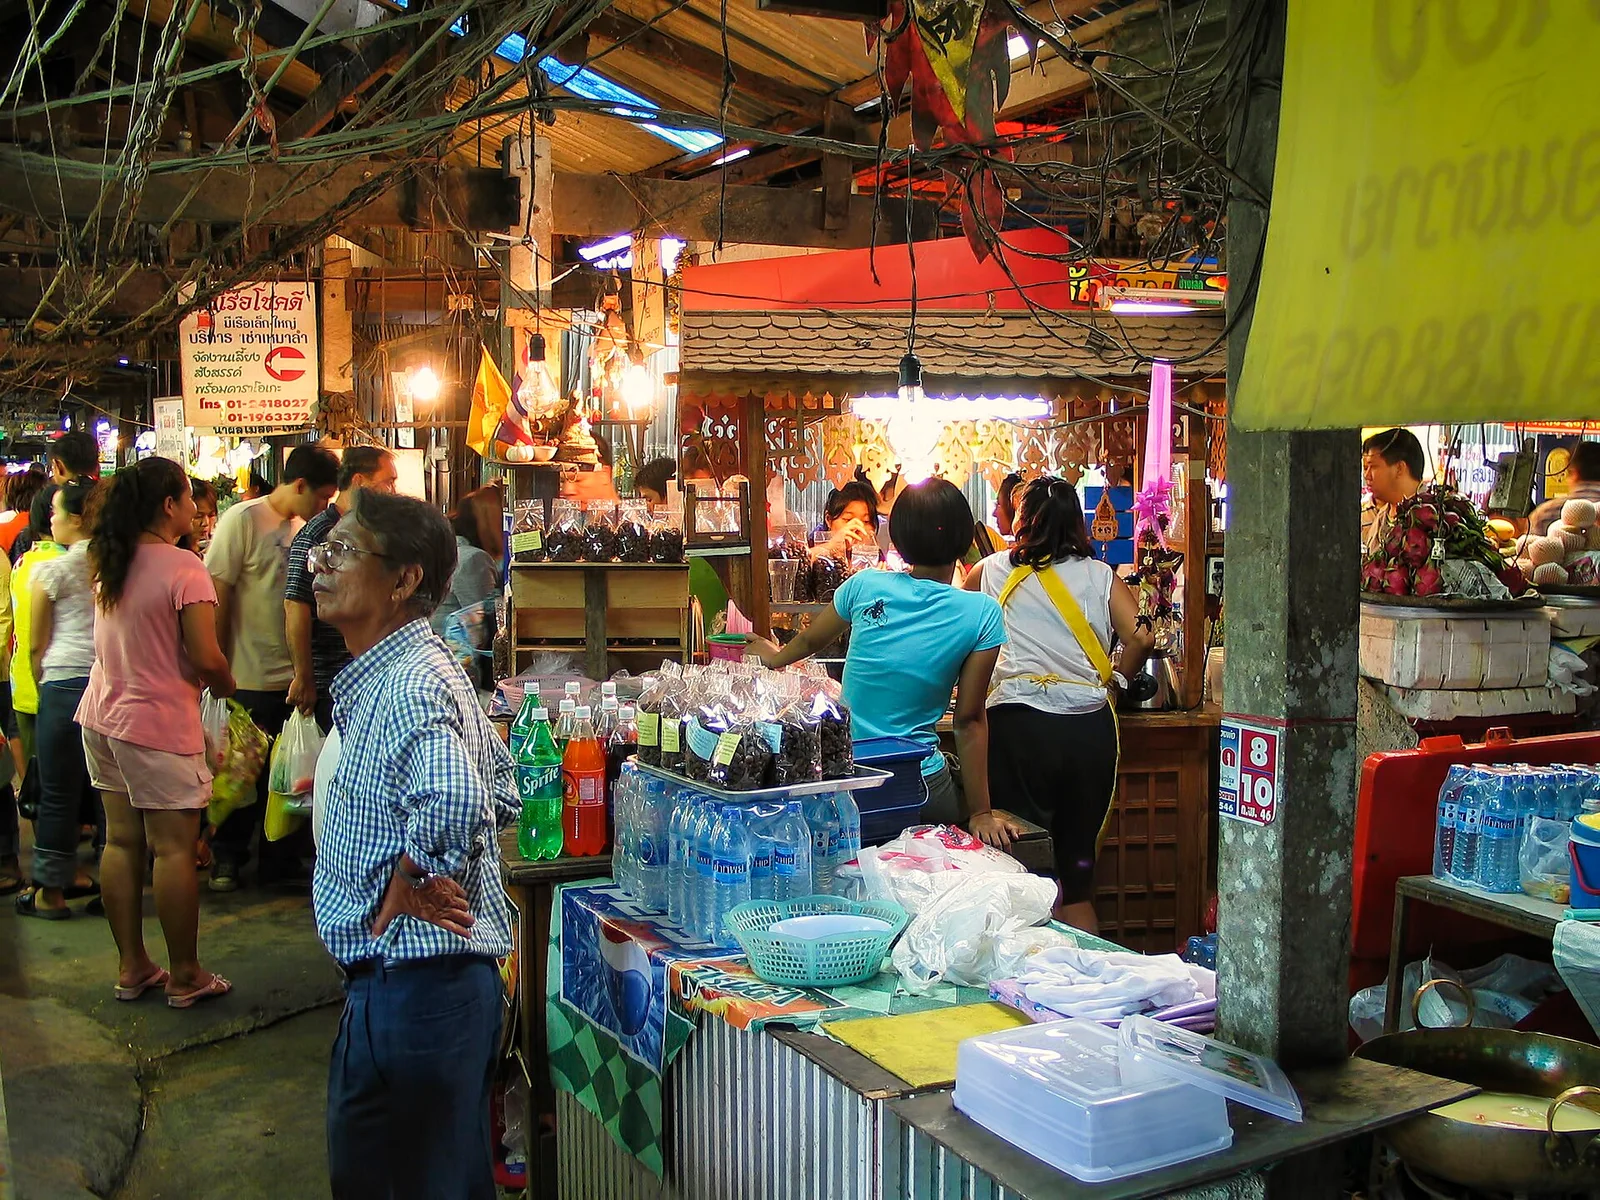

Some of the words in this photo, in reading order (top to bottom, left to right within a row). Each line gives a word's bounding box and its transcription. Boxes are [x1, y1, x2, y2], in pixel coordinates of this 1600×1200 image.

[215, 287, 305, 311] เรือโชคดี
[241, 330, 308, 344] เช่าเหมาลำ
[192, 347, 260, 363] จัดงานเลี้ยง
[199, 397, 221, 409] โทร
[227, 398, 309, 409] 01-2418027
[227, 412, 310, 422] 01-1963372
[1250, 736, 1268, 767] 8
[522, 766, 560, 796] Sprite
[1241, 772, 1273, 807] 10
[1259, 808, 1272, 822] 46
